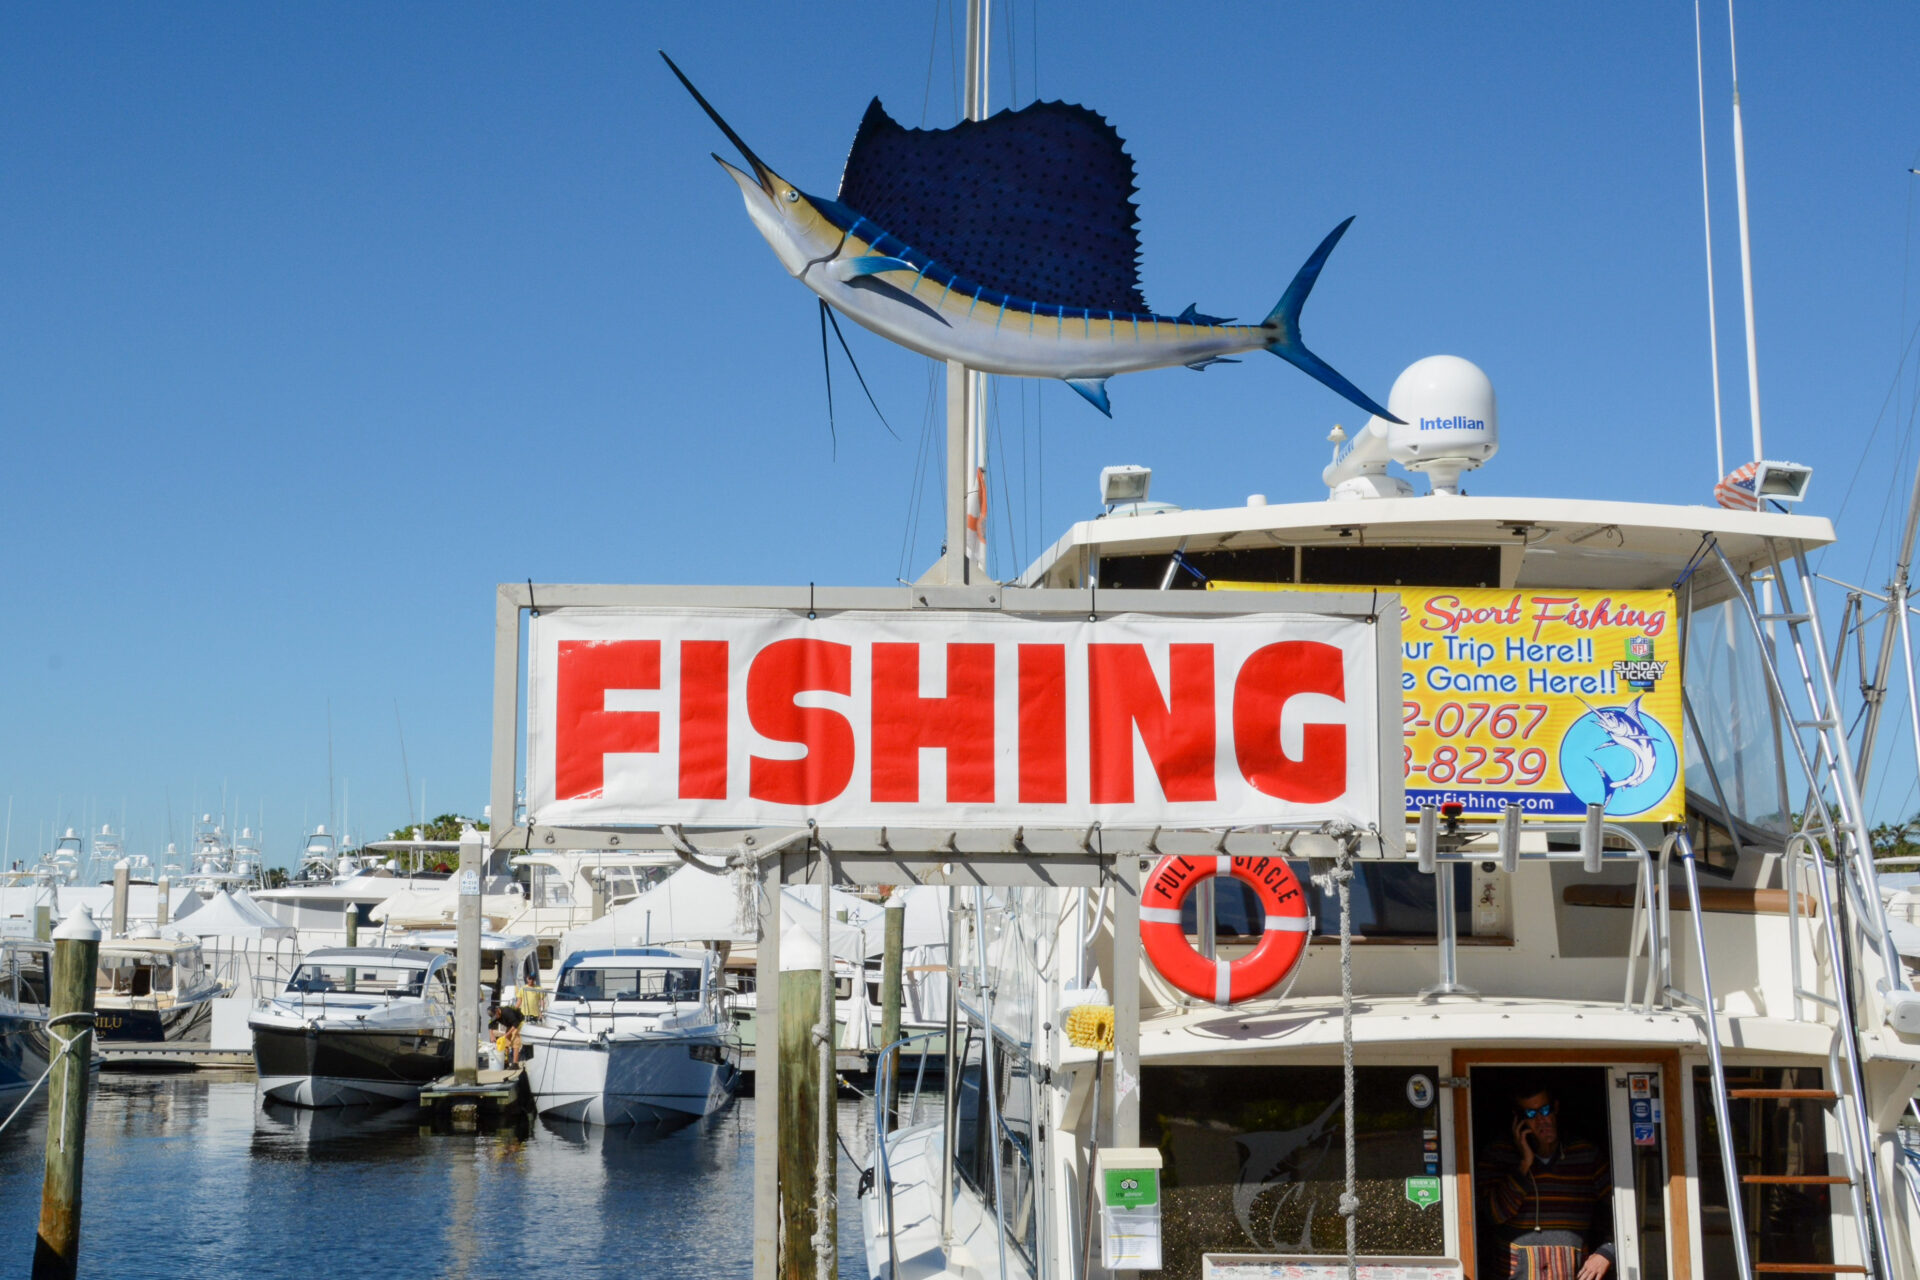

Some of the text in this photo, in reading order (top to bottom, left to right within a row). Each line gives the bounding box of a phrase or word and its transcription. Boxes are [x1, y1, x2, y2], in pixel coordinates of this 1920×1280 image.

[1420, 416, 1485, 431] Intellian
[1420, 594, 1522, 633] Sport
[1531, 597, 1666, 642] Fishing
[1401, 635, 1593, 668] ur Trip Here!!
[1613, 661, 1668, 671] SUNDAY
[1427, 666, 1518, 692] Game
[1529, 668, 1617, 694] Here!!
[1617, 670, 1664, 680] TICKET
[556, 639, 1347, 804] FISHING
[1154, 856, 1299, 903] FULL CIRCLE
